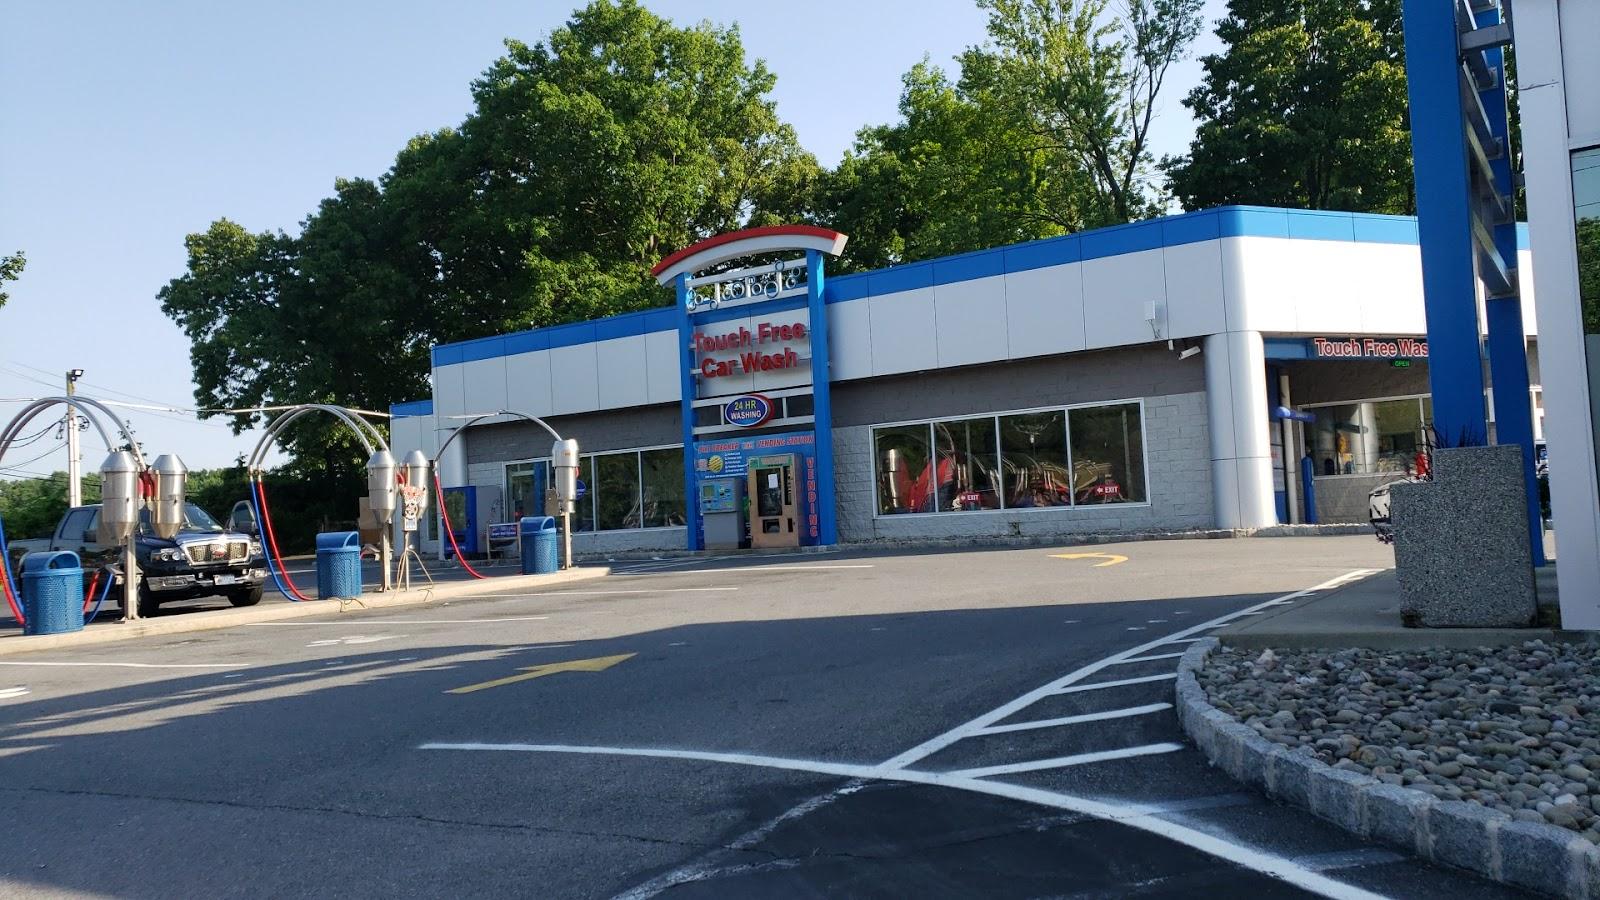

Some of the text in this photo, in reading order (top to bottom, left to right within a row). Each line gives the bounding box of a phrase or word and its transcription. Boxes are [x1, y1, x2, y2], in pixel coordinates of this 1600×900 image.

[693, 322, 807, 353] Touch Free
[1315, 338, 1361, 356] Touch
[1364, 339, 1397, 357] Free
[701, 347, 799, 378] Car Wash
[734, 400, 757, 411] 24 HR
[731, 410, 762, 420] WASHING
[757, 439, 785, 448] VENDING
[806, 456, 818, 537] VENDING
[1104, 485, 1119, 494] EXIT
